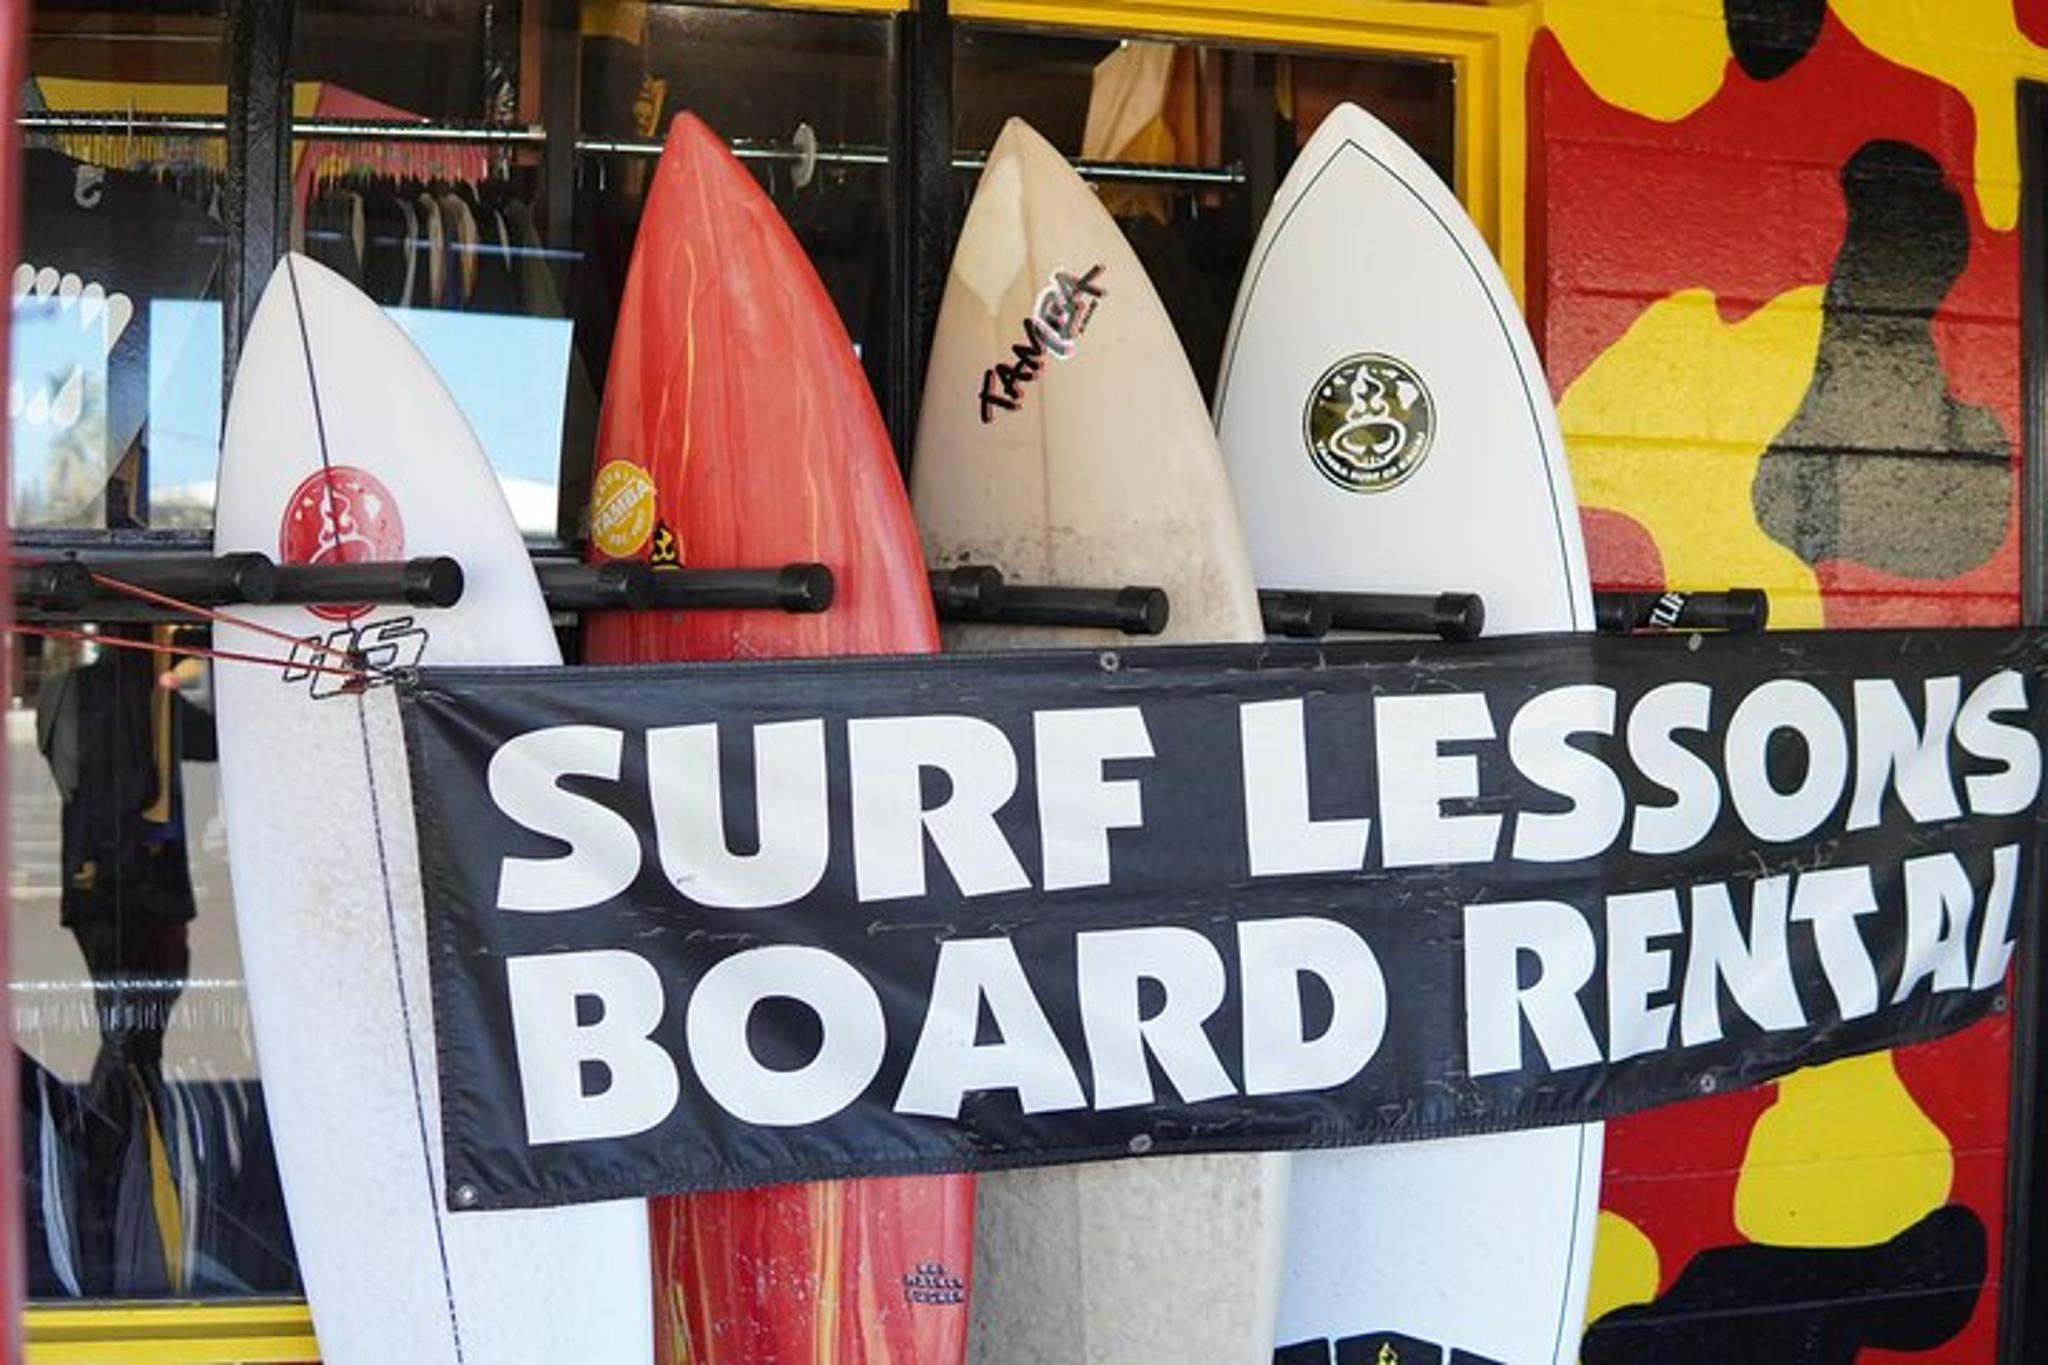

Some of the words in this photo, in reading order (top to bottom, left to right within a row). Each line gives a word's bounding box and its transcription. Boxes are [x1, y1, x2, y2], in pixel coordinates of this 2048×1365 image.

[979, 263, 1107, 424] TAMBA
[487, 706, 1155, 912] SURF
[1239, 671, 2041, 877] LESSONS
[505, 917, 1388, 1146] BOARD
[1463, 844, 2020, 1078] RENTAL
